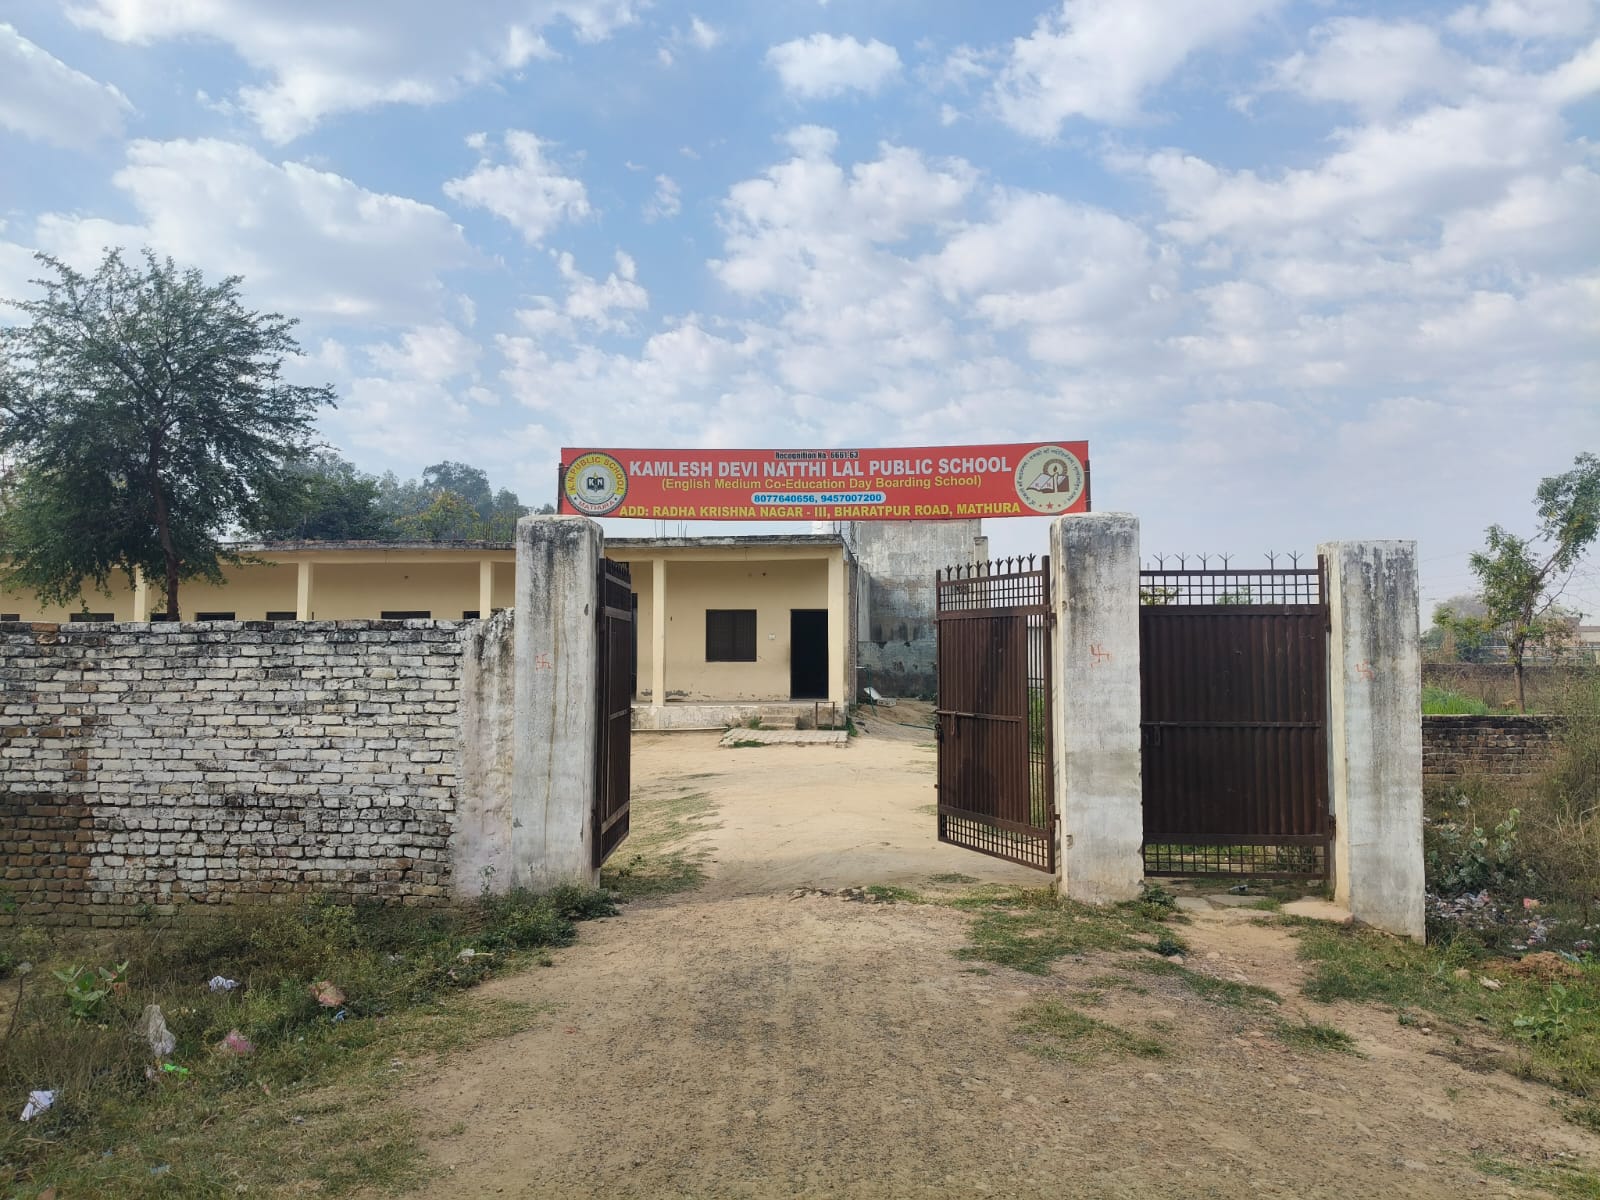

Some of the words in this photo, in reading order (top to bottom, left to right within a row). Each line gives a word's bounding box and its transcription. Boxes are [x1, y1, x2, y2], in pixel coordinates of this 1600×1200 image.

[776, 451, 816, 460] Recognition
[629, 461, 713, 477] KAMLESH
[718, 461, 758, 477] DEVI
[764, 460, 826, 477] NATTHI
[832, 460, 863, 476] LAL
[869, 458, 933, 476] PUBLIC
[938, 456, 1012, 474] SCHOOL
[603, 458, 625, 494] SCHOOL
[662, 478, 711, 490] (English
[714, 478, 761, 490] Medium
[765, 478, 845, 490] Co-Education
[849, 477, 872, 490] Day
[876, 476, 931, 490] Boarding
[934, 474, 982, 488] School)
[754, 494, 818, 503] 8077640656,
[820, 494, 882, 503] 9457007200
[619, 506, 649, 518] ADD:
[653, 506, 696, 518] RADHA
[700, 506, 756, 518] KRISHNA
[760, 506, 803, 518] NAGAR
[834, 505, 911, 517] BHARATPUR
[914, 504, 953, 517] ROAD,
[956, 502, 1021, 515] MATHURA
